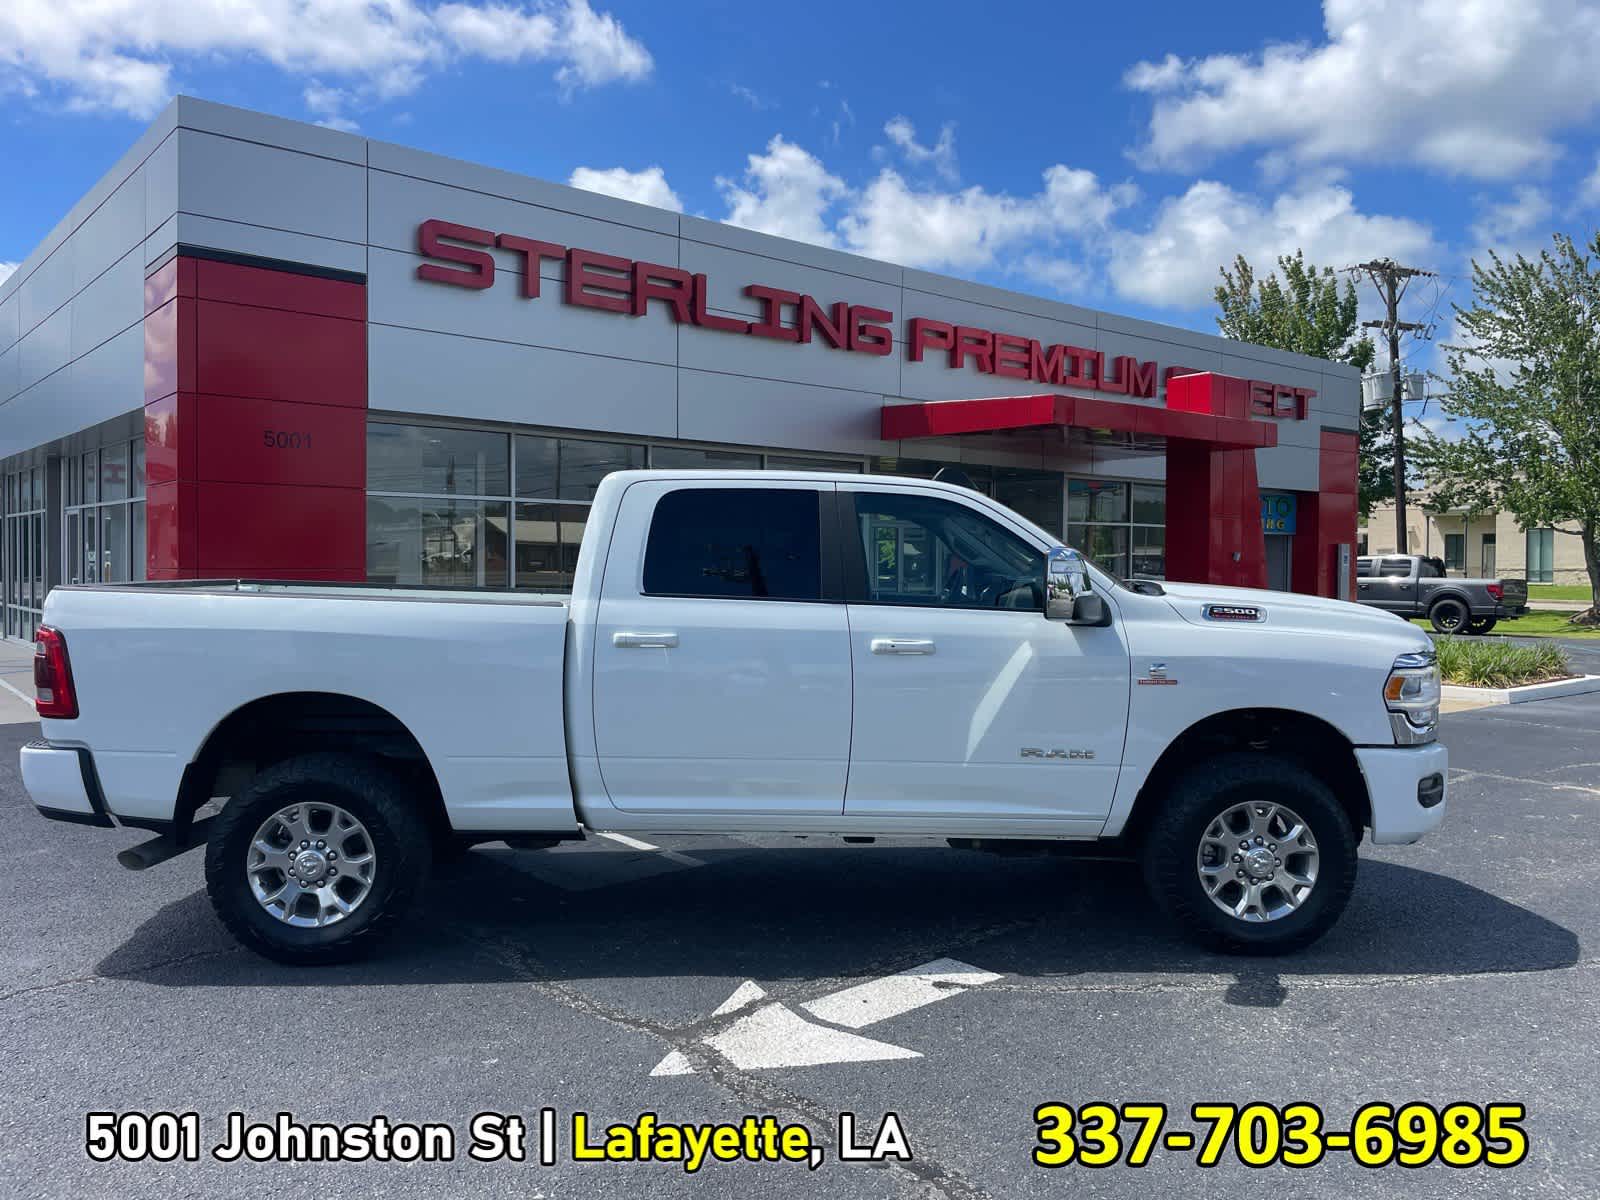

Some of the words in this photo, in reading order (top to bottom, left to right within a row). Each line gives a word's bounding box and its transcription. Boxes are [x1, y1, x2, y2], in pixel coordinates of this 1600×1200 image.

[416, 218, 894, 357] STERLING
[908, 317, 1157, 398] PREMIUM
[263, 430, 312, 449] 5001
[1262, 496, 1293, 517] TO
[1212, 607, 1256, 615] 2500
[1020, 747, 1096, 760] RAM
